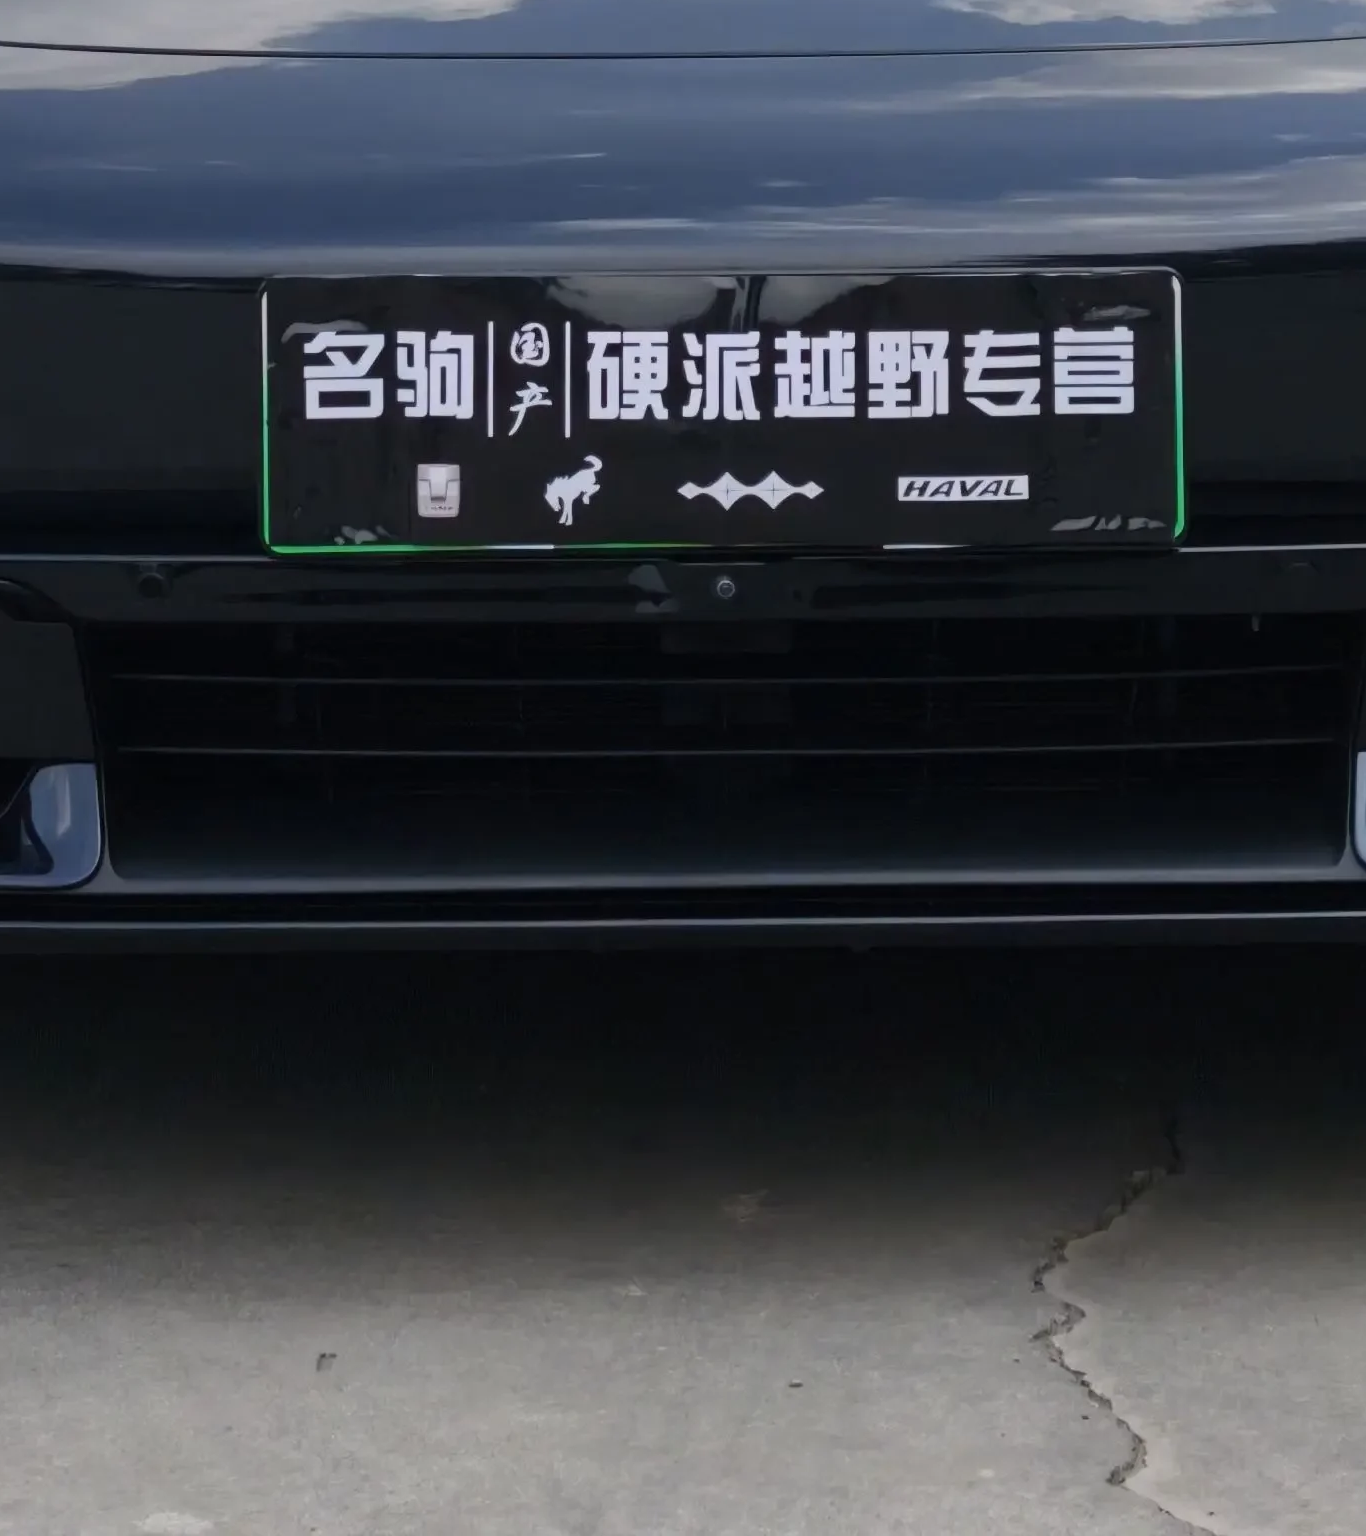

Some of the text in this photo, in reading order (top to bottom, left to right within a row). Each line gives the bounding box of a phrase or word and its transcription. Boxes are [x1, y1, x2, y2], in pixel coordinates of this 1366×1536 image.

[303, 322, 1135, 436] 名驹 国产 硬派越野专营
[902, 478, 1024, 498] HAVAL
